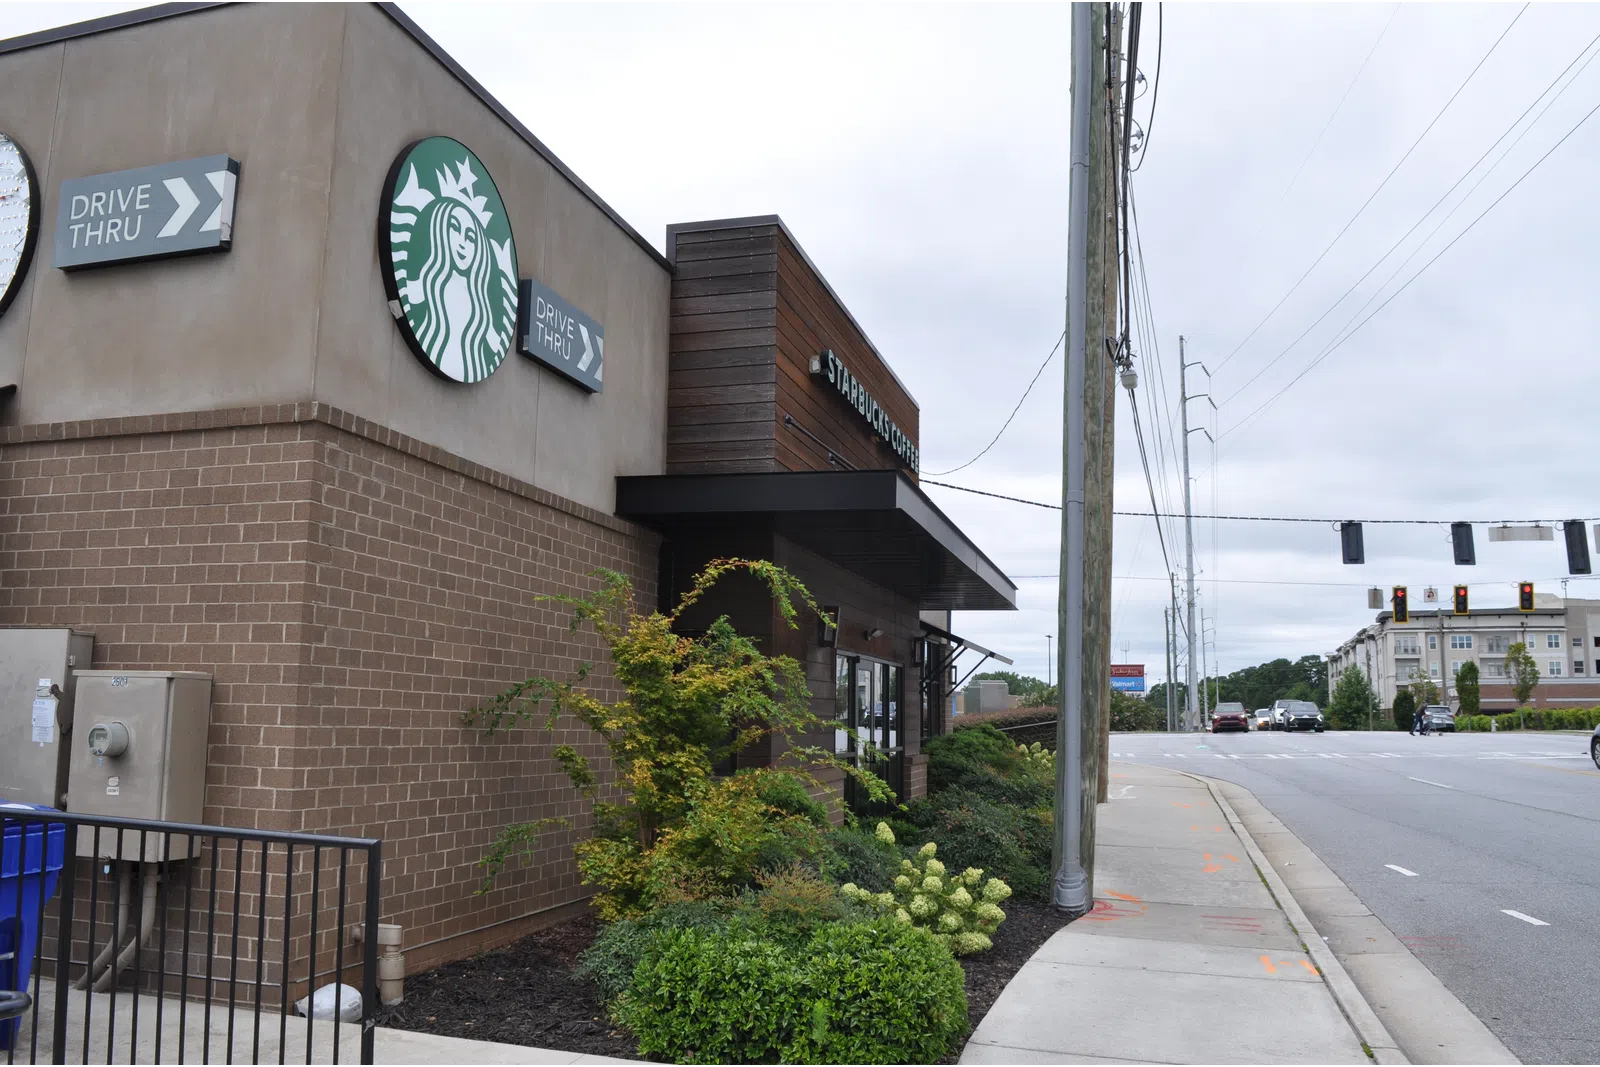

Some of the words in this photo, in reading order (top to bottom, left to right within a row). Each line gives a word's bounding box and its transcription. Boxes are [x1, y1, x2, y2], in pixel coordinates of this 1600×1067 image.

[70, 183, 151, 220] DRIVE
[69, 215, 142, 248] THRU
[536, 296, 574, 339] DRIVE
[536, 321, 571, 360] THRU
[828, 349, 889, 441] STARBUCKS
[891, 422, 919, 474] COFFEE
